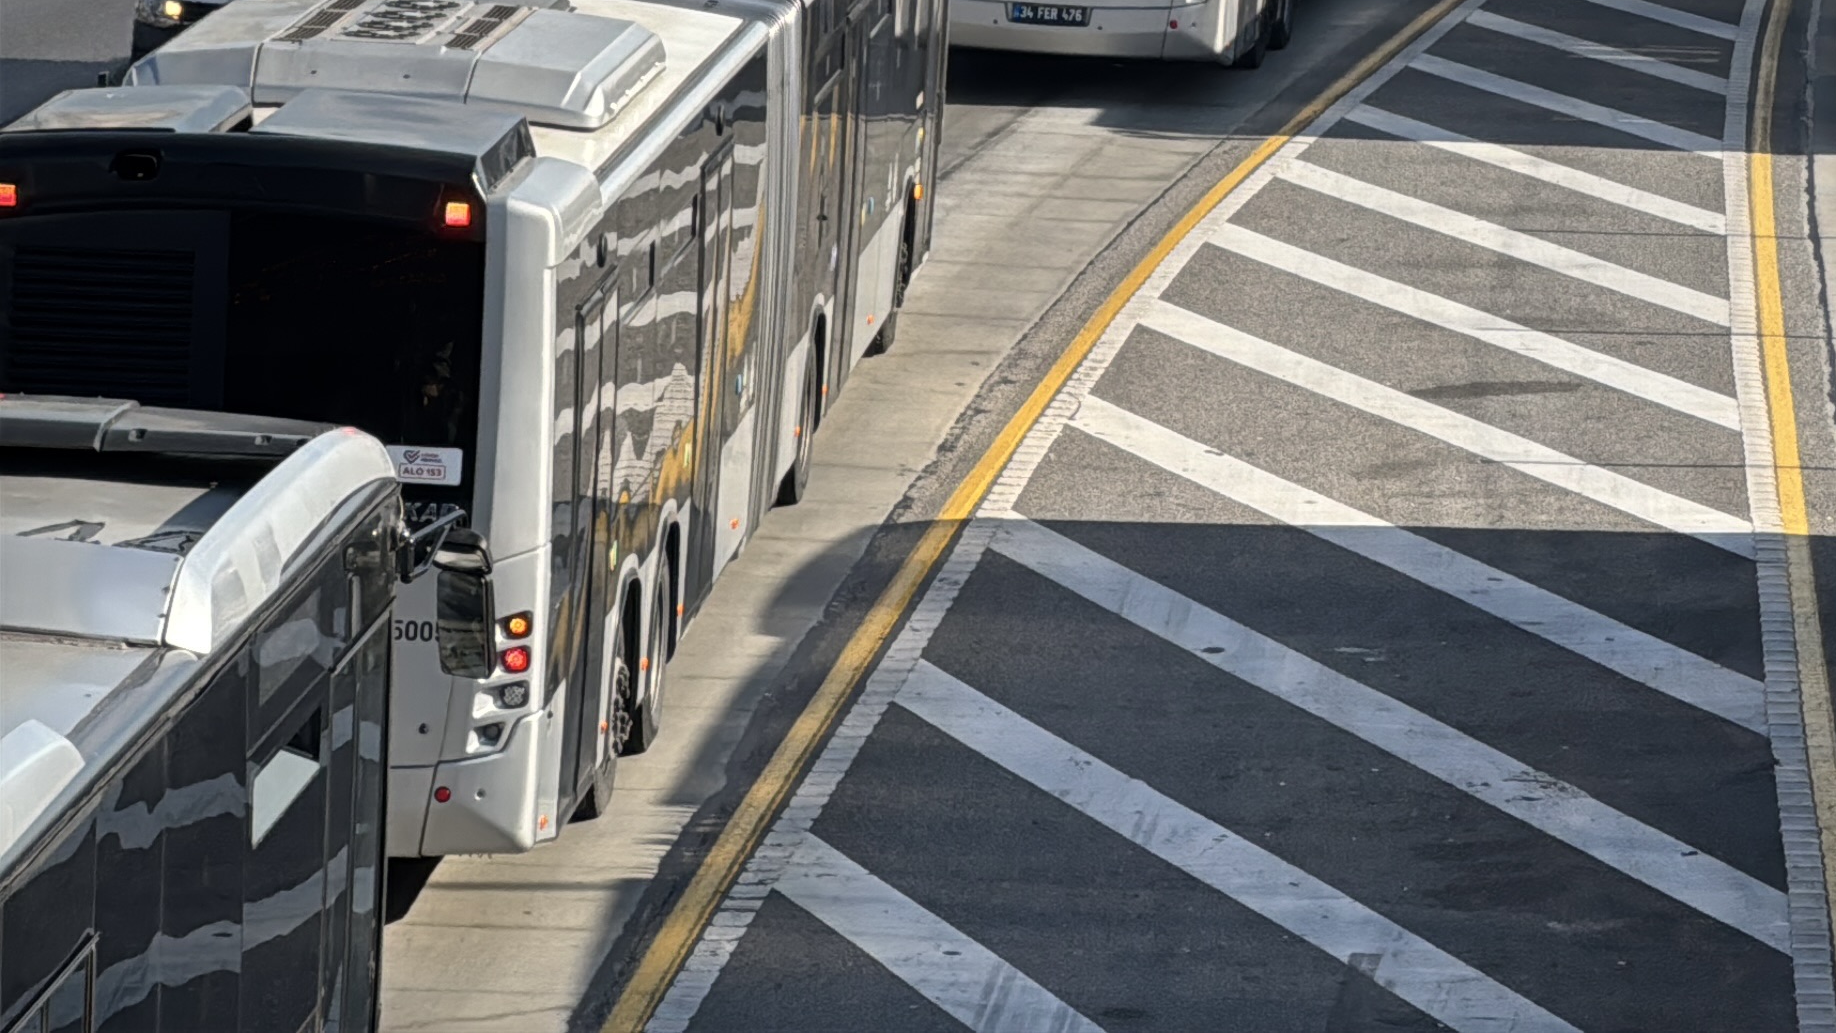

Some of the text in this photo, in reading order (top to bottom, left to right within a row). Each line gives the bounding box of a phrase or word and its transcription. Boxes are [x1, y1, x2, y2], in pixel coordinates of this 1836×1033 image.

[1020, 5, 1083, 22] 34 FER 476
[402, 466, 442, 477] ALO 153
